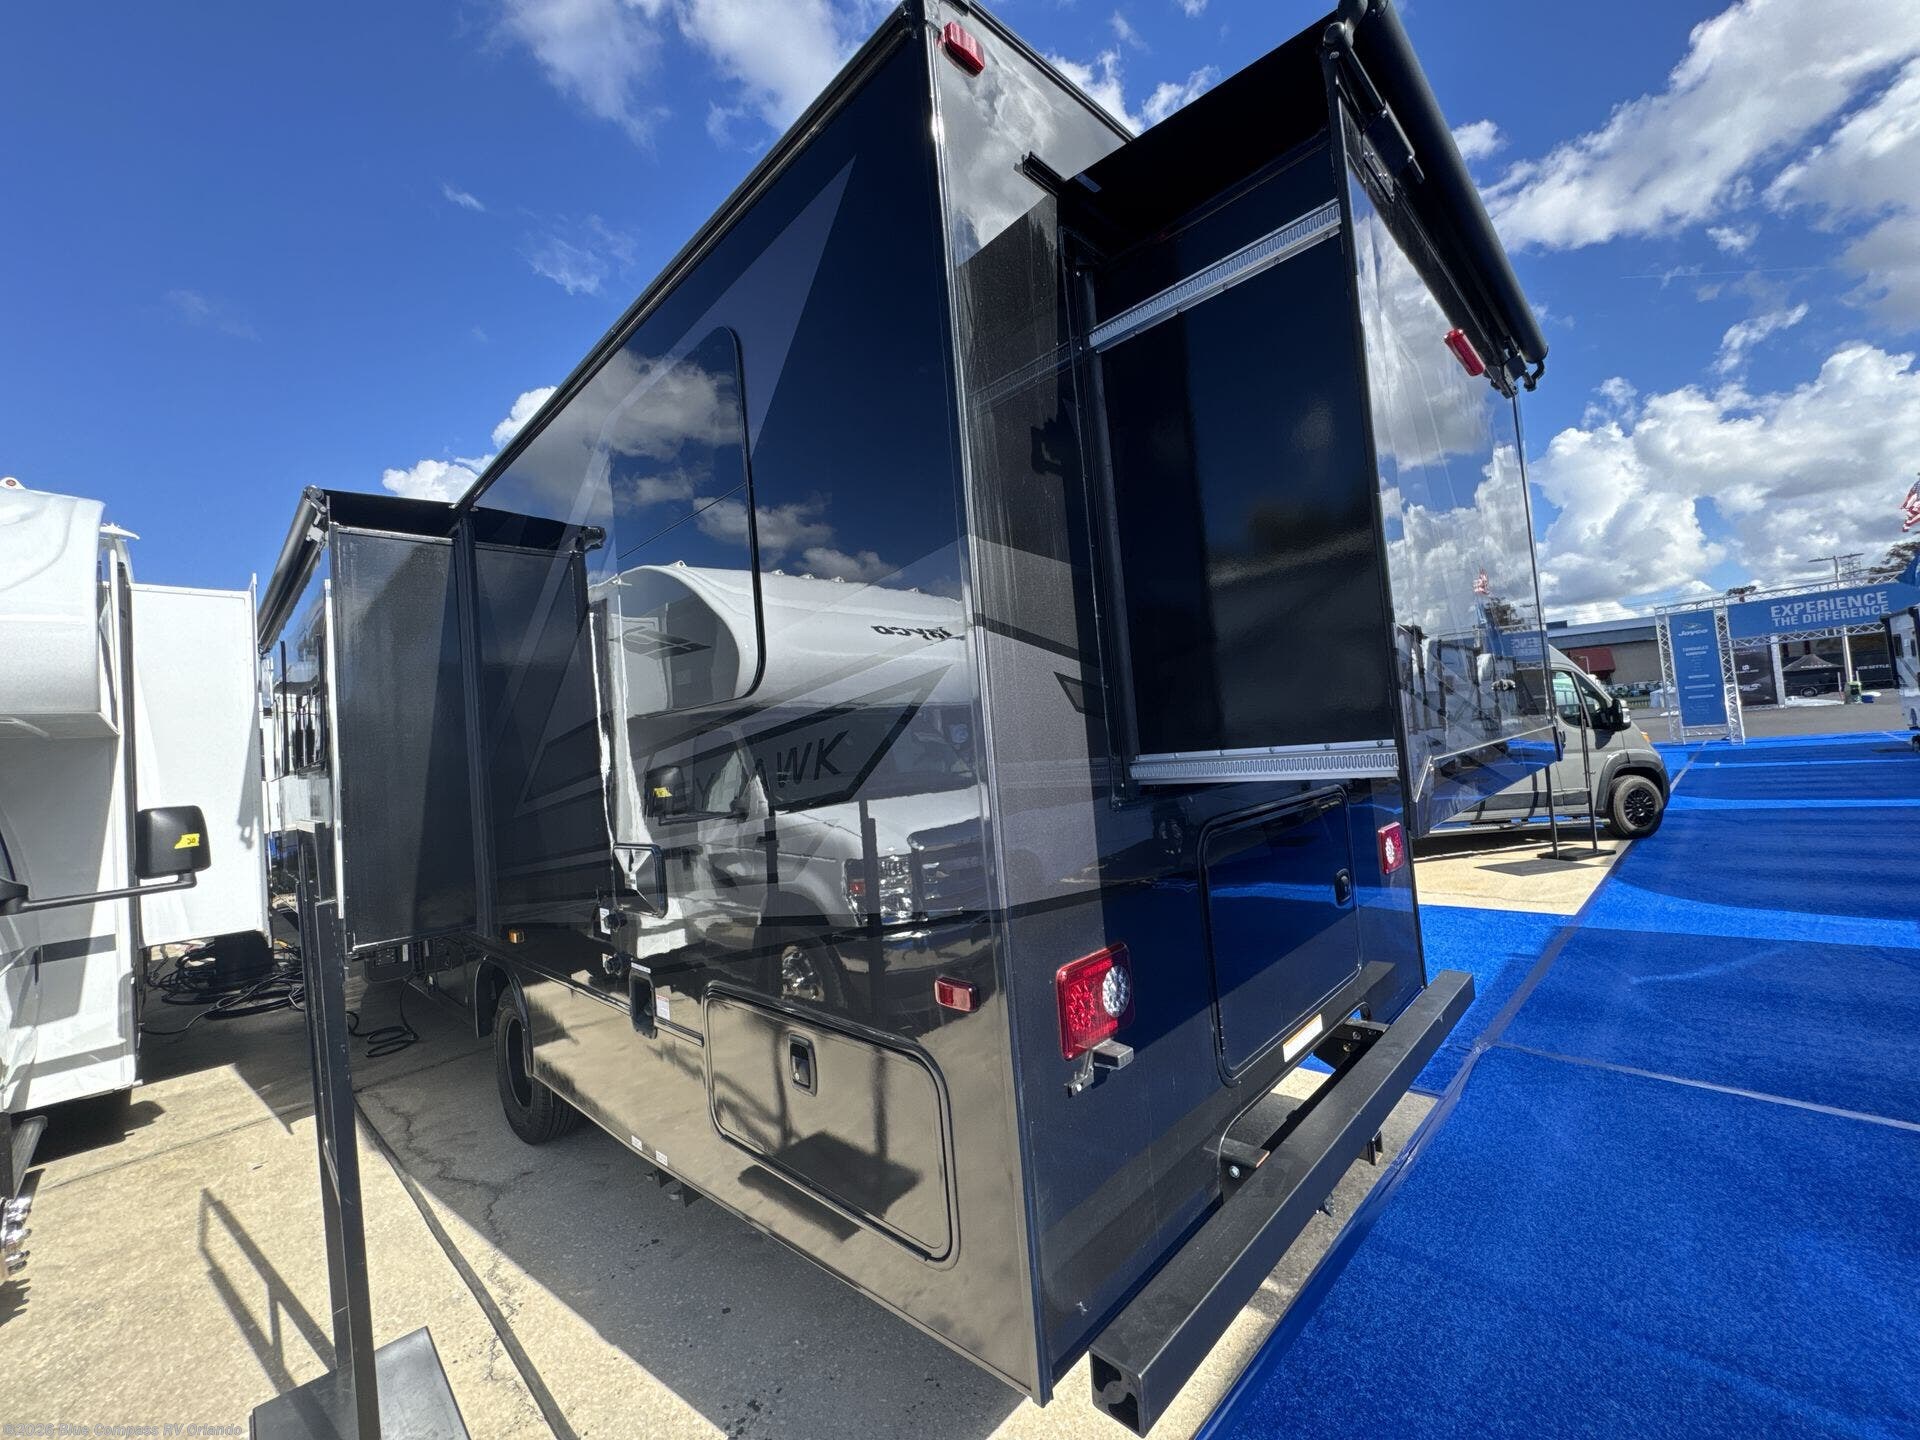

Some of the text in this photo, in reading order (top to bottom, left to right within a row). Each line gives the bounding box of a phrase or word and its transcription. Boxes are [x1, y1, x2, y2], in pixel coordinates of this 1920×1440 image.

[1770, 591, 1889, 618] EXPERIENCE
[1772, 604, 1890, 627] THE DIFFERENCE
[1677, 628, 1709, 637] Jayco
